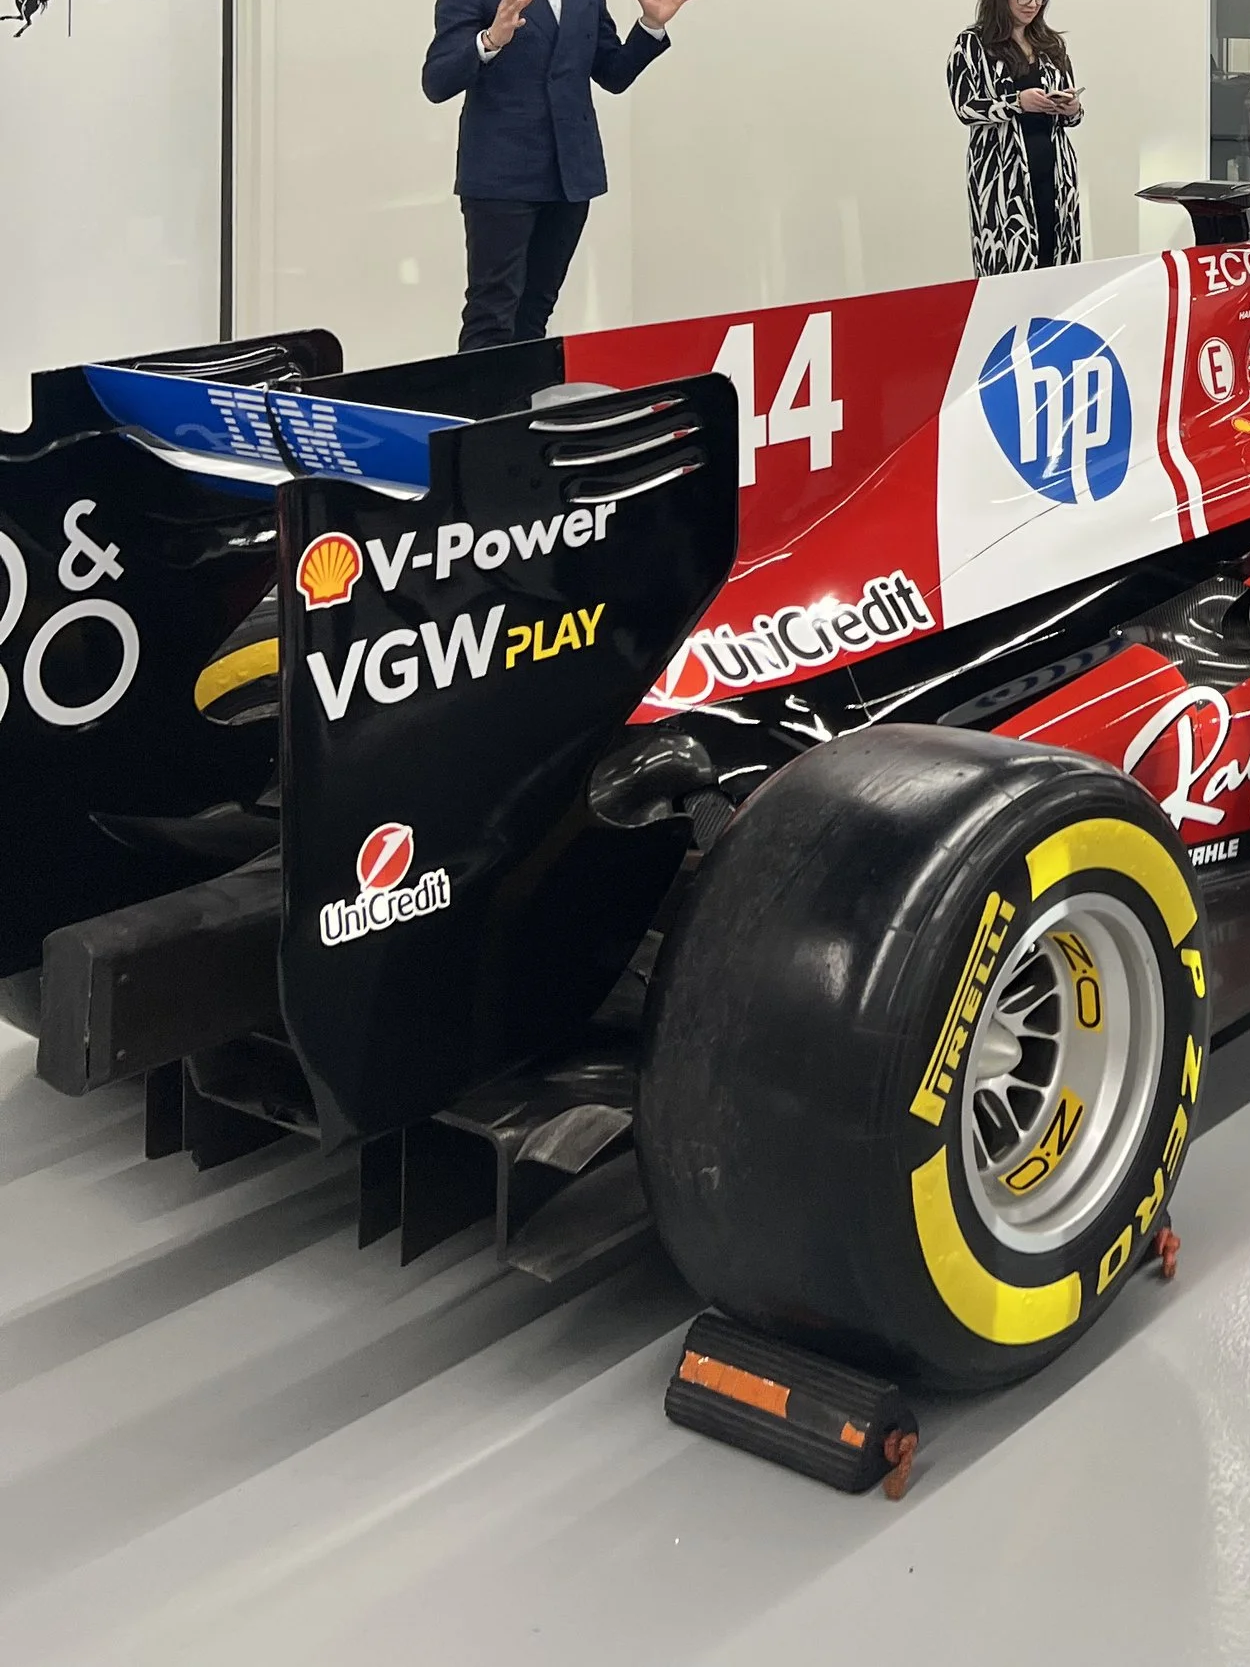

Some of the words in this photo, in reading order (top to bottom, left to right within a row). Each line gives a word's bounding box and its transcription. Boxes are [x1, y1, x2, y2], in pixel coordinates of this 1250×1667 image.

[711, 311, 843, 488] 44
[1011, 324, 1113, 503] hp
[1208, 344, 1227, 396] E
[207, 388, 363, 475] IBM
[366, 499, 617, 592] V-Power
[306, 604, 506, 721] VGW
[505, 603, 606, 669] PLAY
[700, 576, 927, 681] UniCredit
[1188, 837, 1240, 867] AHLE
[324, 874, 448, 940] UniCredit
[909, 891, 1016, 1127] PIRELLI
[1180, 947, 1206, 999] P
[1096, 1033, 1204, 1296] ZERO
